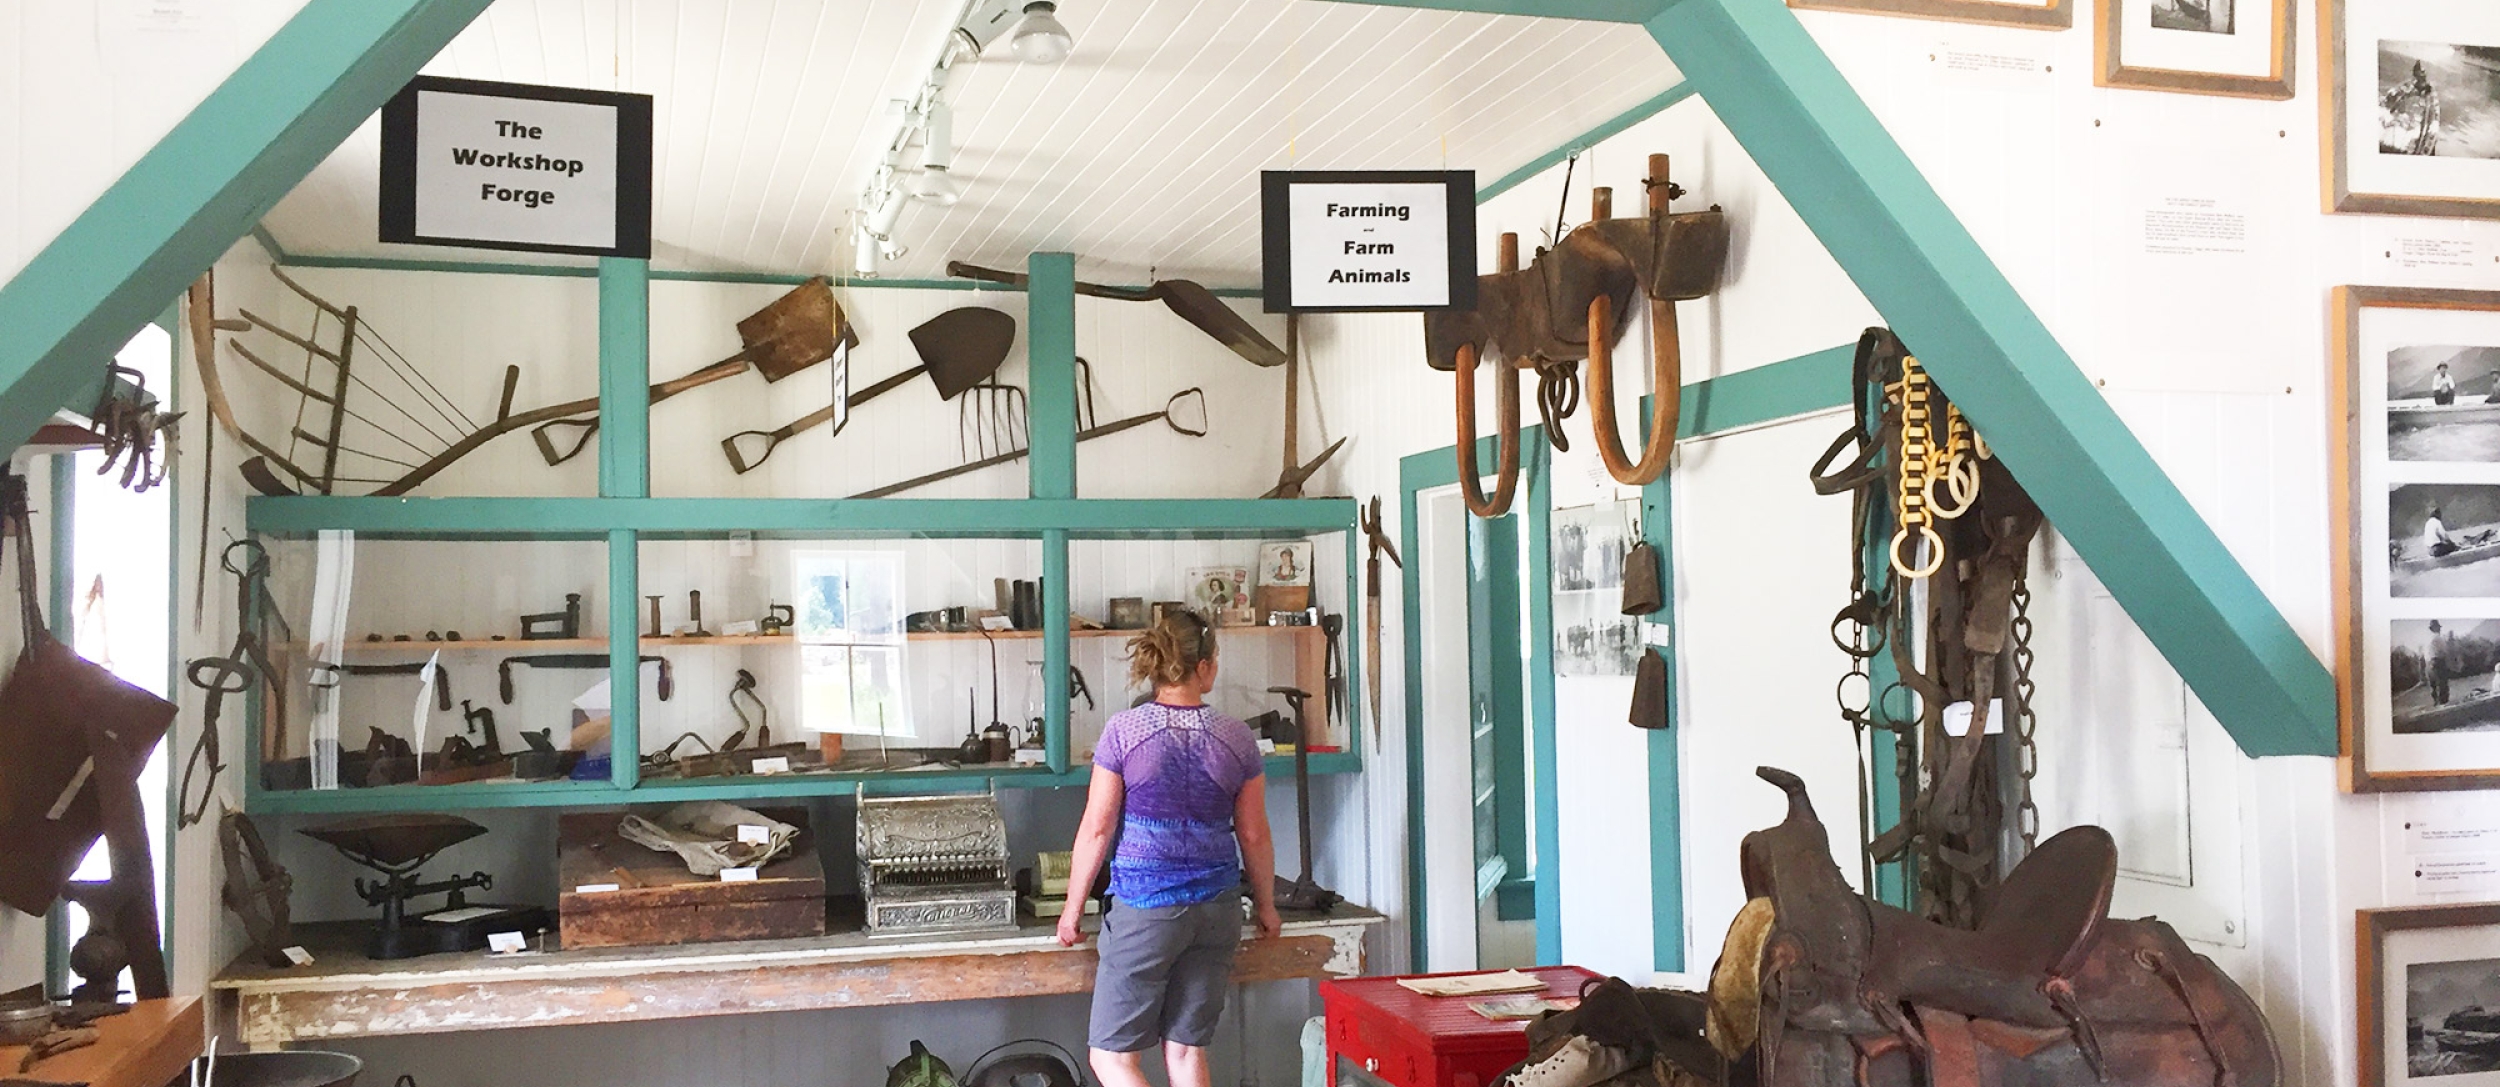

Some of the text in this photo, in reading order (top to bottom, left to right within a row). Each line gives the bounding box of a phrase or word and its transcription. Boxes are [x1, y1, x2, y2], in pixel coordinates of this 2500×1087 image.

[495, 121, 542, 140] The
[452, 148, 583, 177] Workshop
[482, 183, 554, 208] Forge
[1327, 203, 1409, 221] Farming
[1345, 241, 1394, 254] Farm
[1328, 269, 1410, 283] Animals
